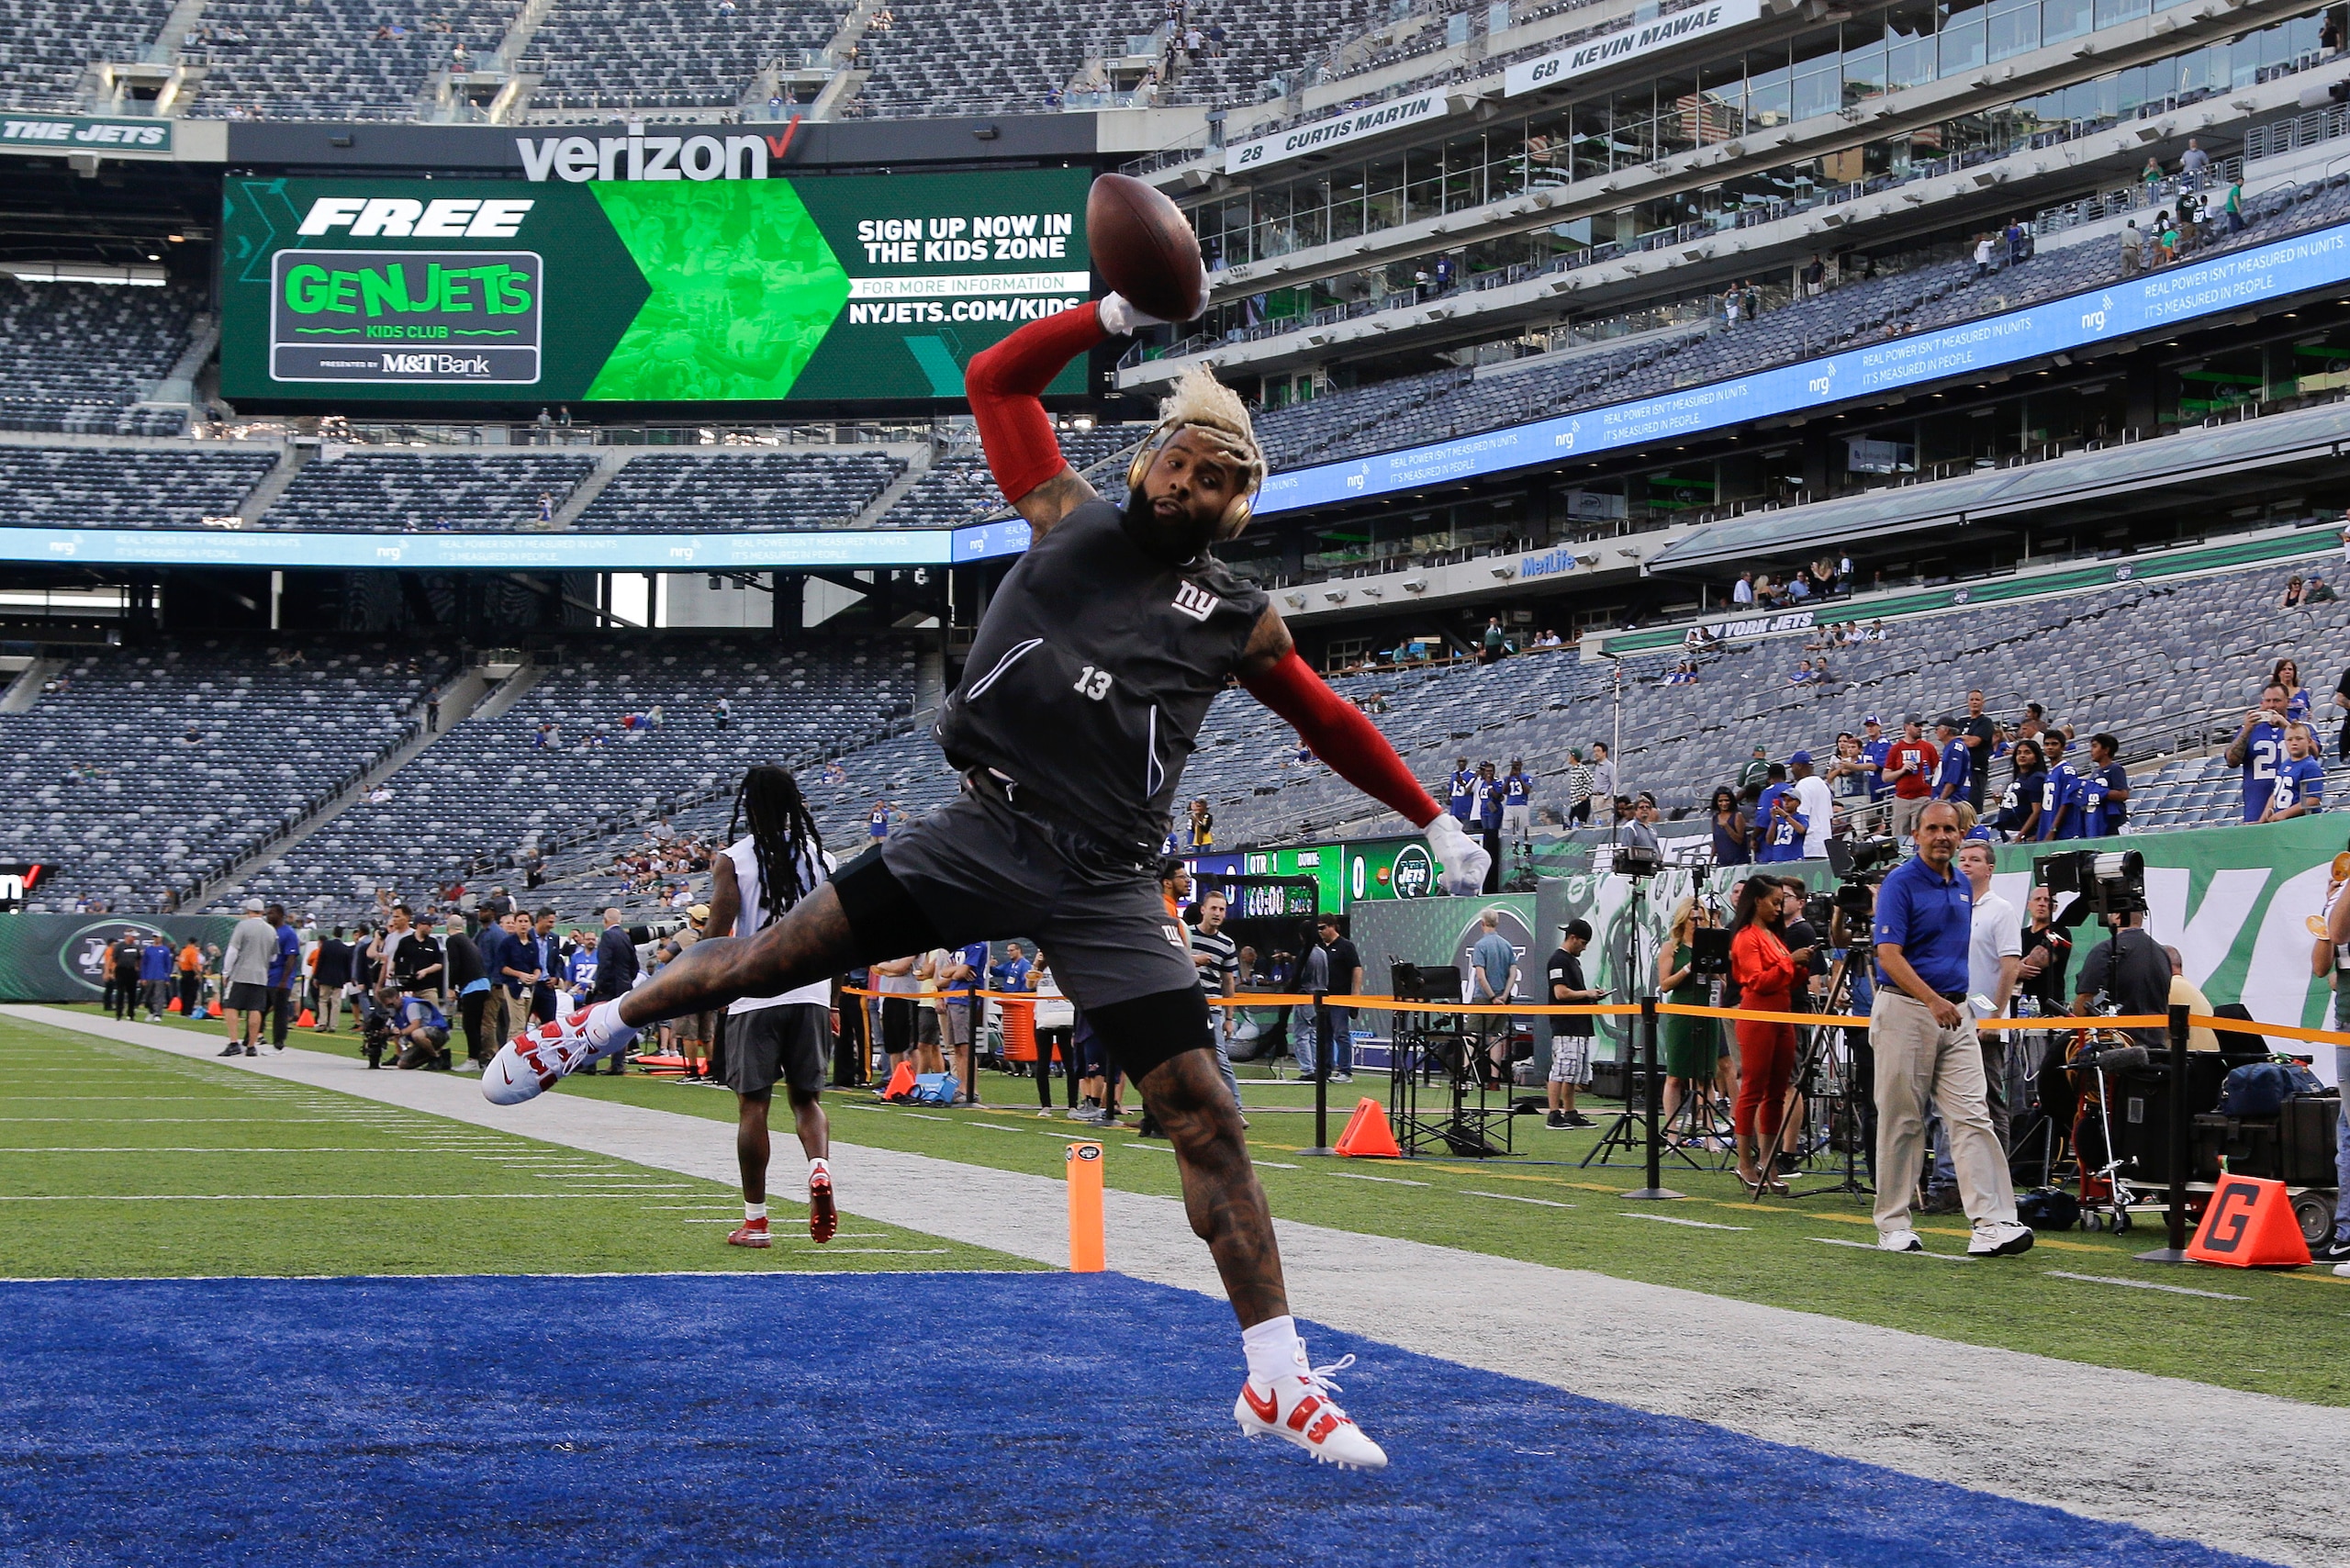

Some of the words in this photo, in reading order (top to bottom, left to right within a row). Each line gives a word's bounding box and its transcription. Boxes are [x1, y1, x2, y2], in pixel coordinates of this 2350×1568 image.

[1532, 60, 1560, 81] 68
[1571, 33, 1635, 69] KEVIN
[1638, 6, 1722, 47] MAWAE
[3, 120, 74, 140] THE
[75, 124, 166, 145] JETS
[1239, 145, 1263, 163] 28
[1285, 119, 1352, 151] CURTIS
[1355, 96, 1432, 132] MARTIN
[515, 123, 768, 182] verizon
[297, 197, 535, 237] FREE
[857, 218, 923, 241] SIGN
[929, 218, 967, 240] UP
[973, 215, 1038, 238] NOW
[1044, 213, 1072, 235] IN
[864, 241, 917, 263] THE
[924, 240, 988, 262] KIDS
[994, 237, 1066, 260] ZONE
[2145, 286, 2169, 299] REAL
[2172, 273, 2208, 292] POWER
[2210, 263, 2235, 282] ISN'T
[2237, 251, 2295, 274] MEASURED
[2298, 245, 2308, 258] IN
[863, 282, 894, 295] FOR
[900, 280, 946, 294] MORE
[952, 276, 1065, 293] INFORMATION
[2144, 304, 2163, 319] IT'S
[2165, 291, 2219, 315] MEASURED
[2221, 286, 2232, 299] IN
[366, 325, 404, 338] KIDS
[407, 325, 449, 339] CLUB
[2082, 309, 2106, 330] nrg
[1863, 354, 1883, 367] REAL
[1886, 346, 1917, 364] POWER
[1918, 340, 1941, 354] ISN'T
[1942, 328, 1990, 348] MEASURED
[1992, 324, 2002, 337] IN
[1863, 372, 1878, 386] IT'S
[1879, 361, 1926, 381] MEASURED
[1927, 358, 1937, 371] IN
[1809, 378, 1830, 395] nrg
[1604, 410, 1622, 424] REAL
[1623, 407, 1651, 422] POWER
[1673, 393, 1715, 412] MEASURED
[1716, 391, 1724, 402] IN
[1555, 432, 1574, 449] nrg
[1604, 429, 1617, 442] IT'S
[1617, 421, 1659, 440] MEASURED
[1660, 420, 1669, 431] IN
[1391, 457, 1407, 468] REAL
[1409, 454, 1433, 465] POWER
[1452, 442, 1488, 456] MEASURED
[1489, 438, 1497, 448] IN
[1347, 474, 1364, 489] nrg
[1391, 473, 1403, 484] IT'S
[1404, 466, 1440, 481] MEASURED
[1442, 464, 1449, 474] IN
[669, 547, 695, 561] nrg
[969, 539, 985, 553] nrg
[1521, 549, 1575, 577] MetLife
[1724, 618, 1771, 637] YORK
[1770, 612, 1815, 631] JETS
[1073, 666, 1113, 700] 13
[1509, 781, 1523, 796] 13
[1774, 824, 1794, 846] 13
[1272, 852, 1277, 872] 1
[1352, 856, 1366, 901] 0
[1398, 867, 1426, 884] JETS
[576, 964, 598, 982] 27
[2203, 1182, 2260, 1253] G
